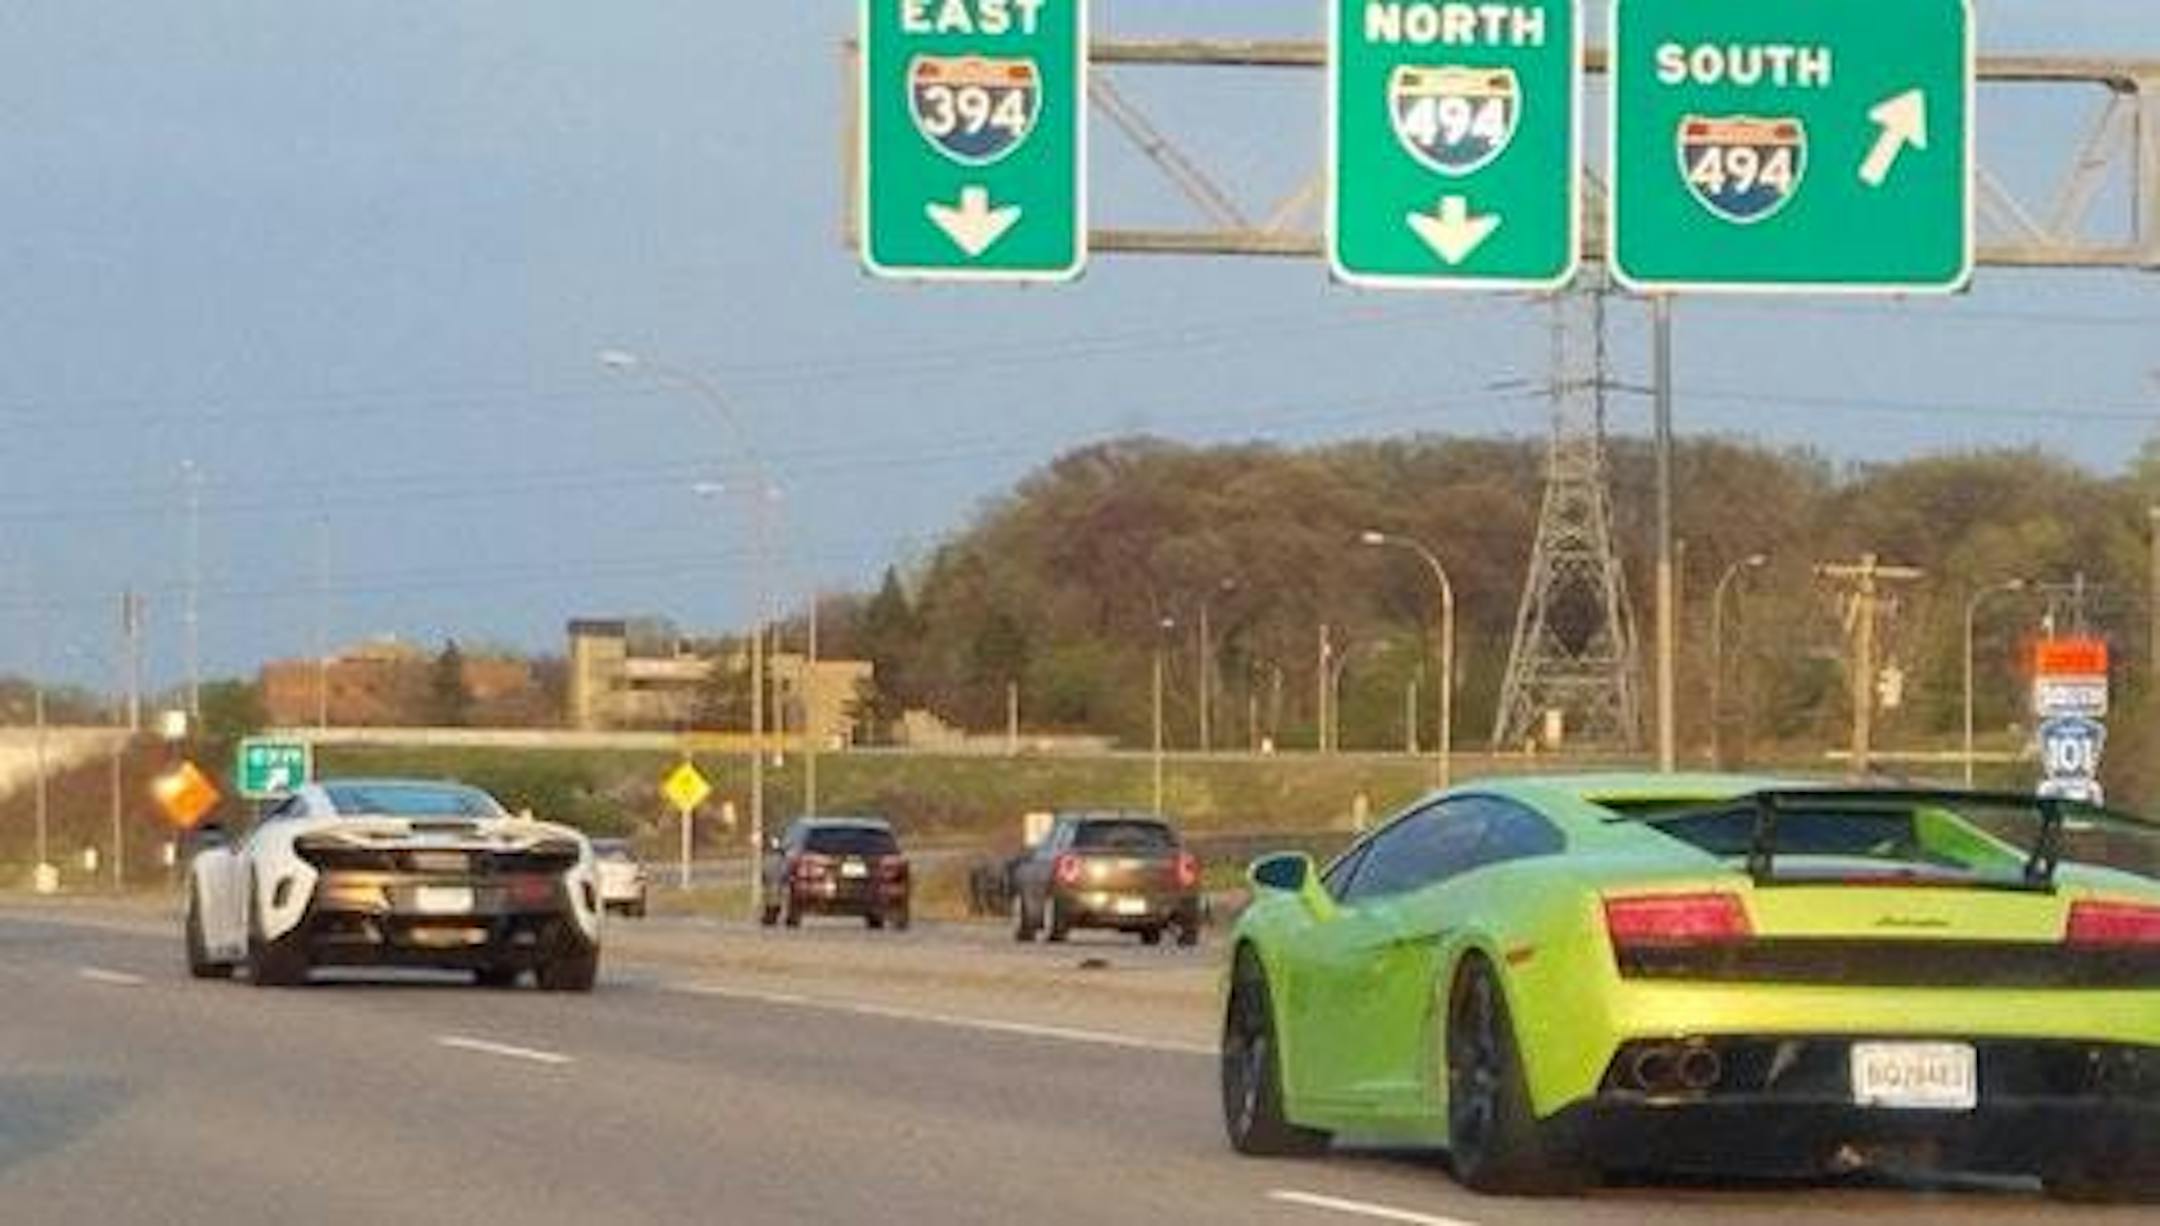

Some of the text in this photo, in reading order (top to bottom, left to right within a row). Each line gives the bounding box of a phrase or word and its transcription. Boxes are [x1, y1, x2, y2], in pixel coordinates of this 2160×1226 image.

[902, 0, 1044, 35] EAST
[1364, 3, 1546, 46] NORTH
[1654, 43, 1832, 87] SOUTH
[922, 85, 1027, 137] 394
[1404, 96, 1505, 145] 494
[1689, 146, 1793, 195] 494
[2048, 735, 2093, 771] 101
